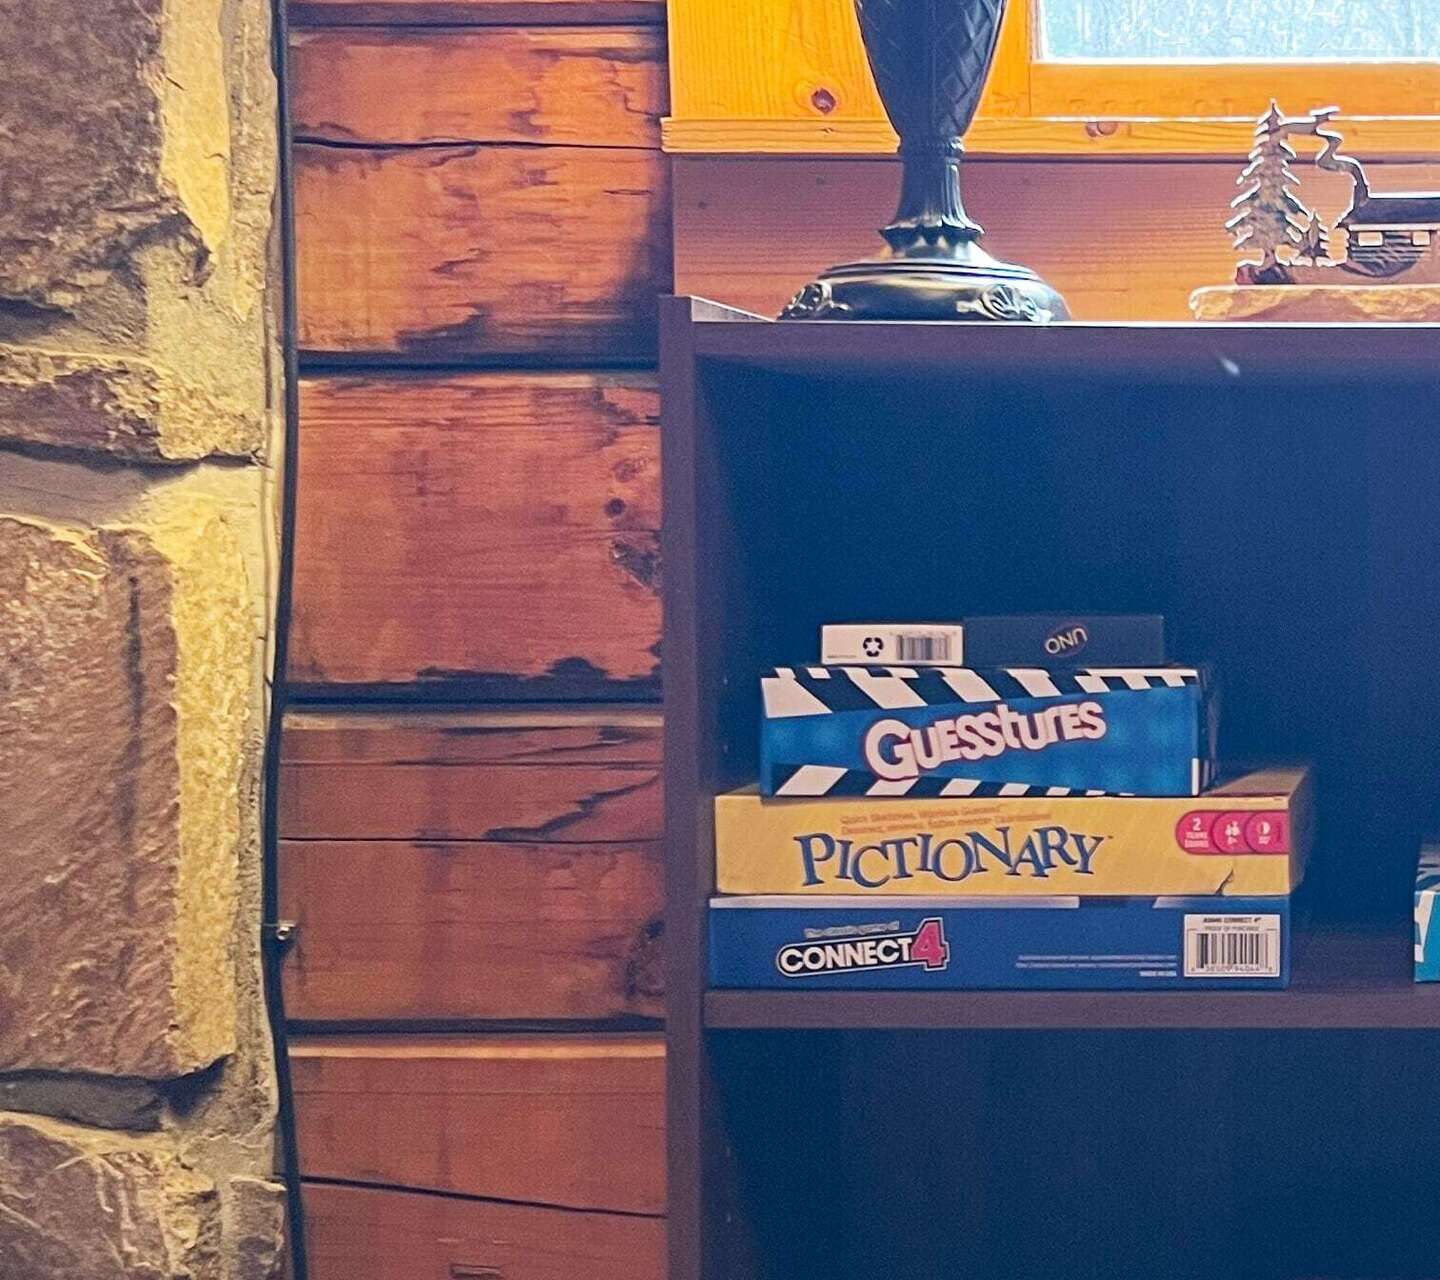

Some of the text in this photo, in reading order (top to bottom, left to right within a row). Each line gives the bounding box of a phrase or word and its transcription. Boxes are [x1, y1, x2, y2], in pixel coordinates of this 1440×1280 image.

[1045, 628, 1088, 655] UNO
[793, 825, 1104, 888] PICTIONARY
[780, 937, 913, 972] CONNECT
[911, 920, 946, 967] 4
